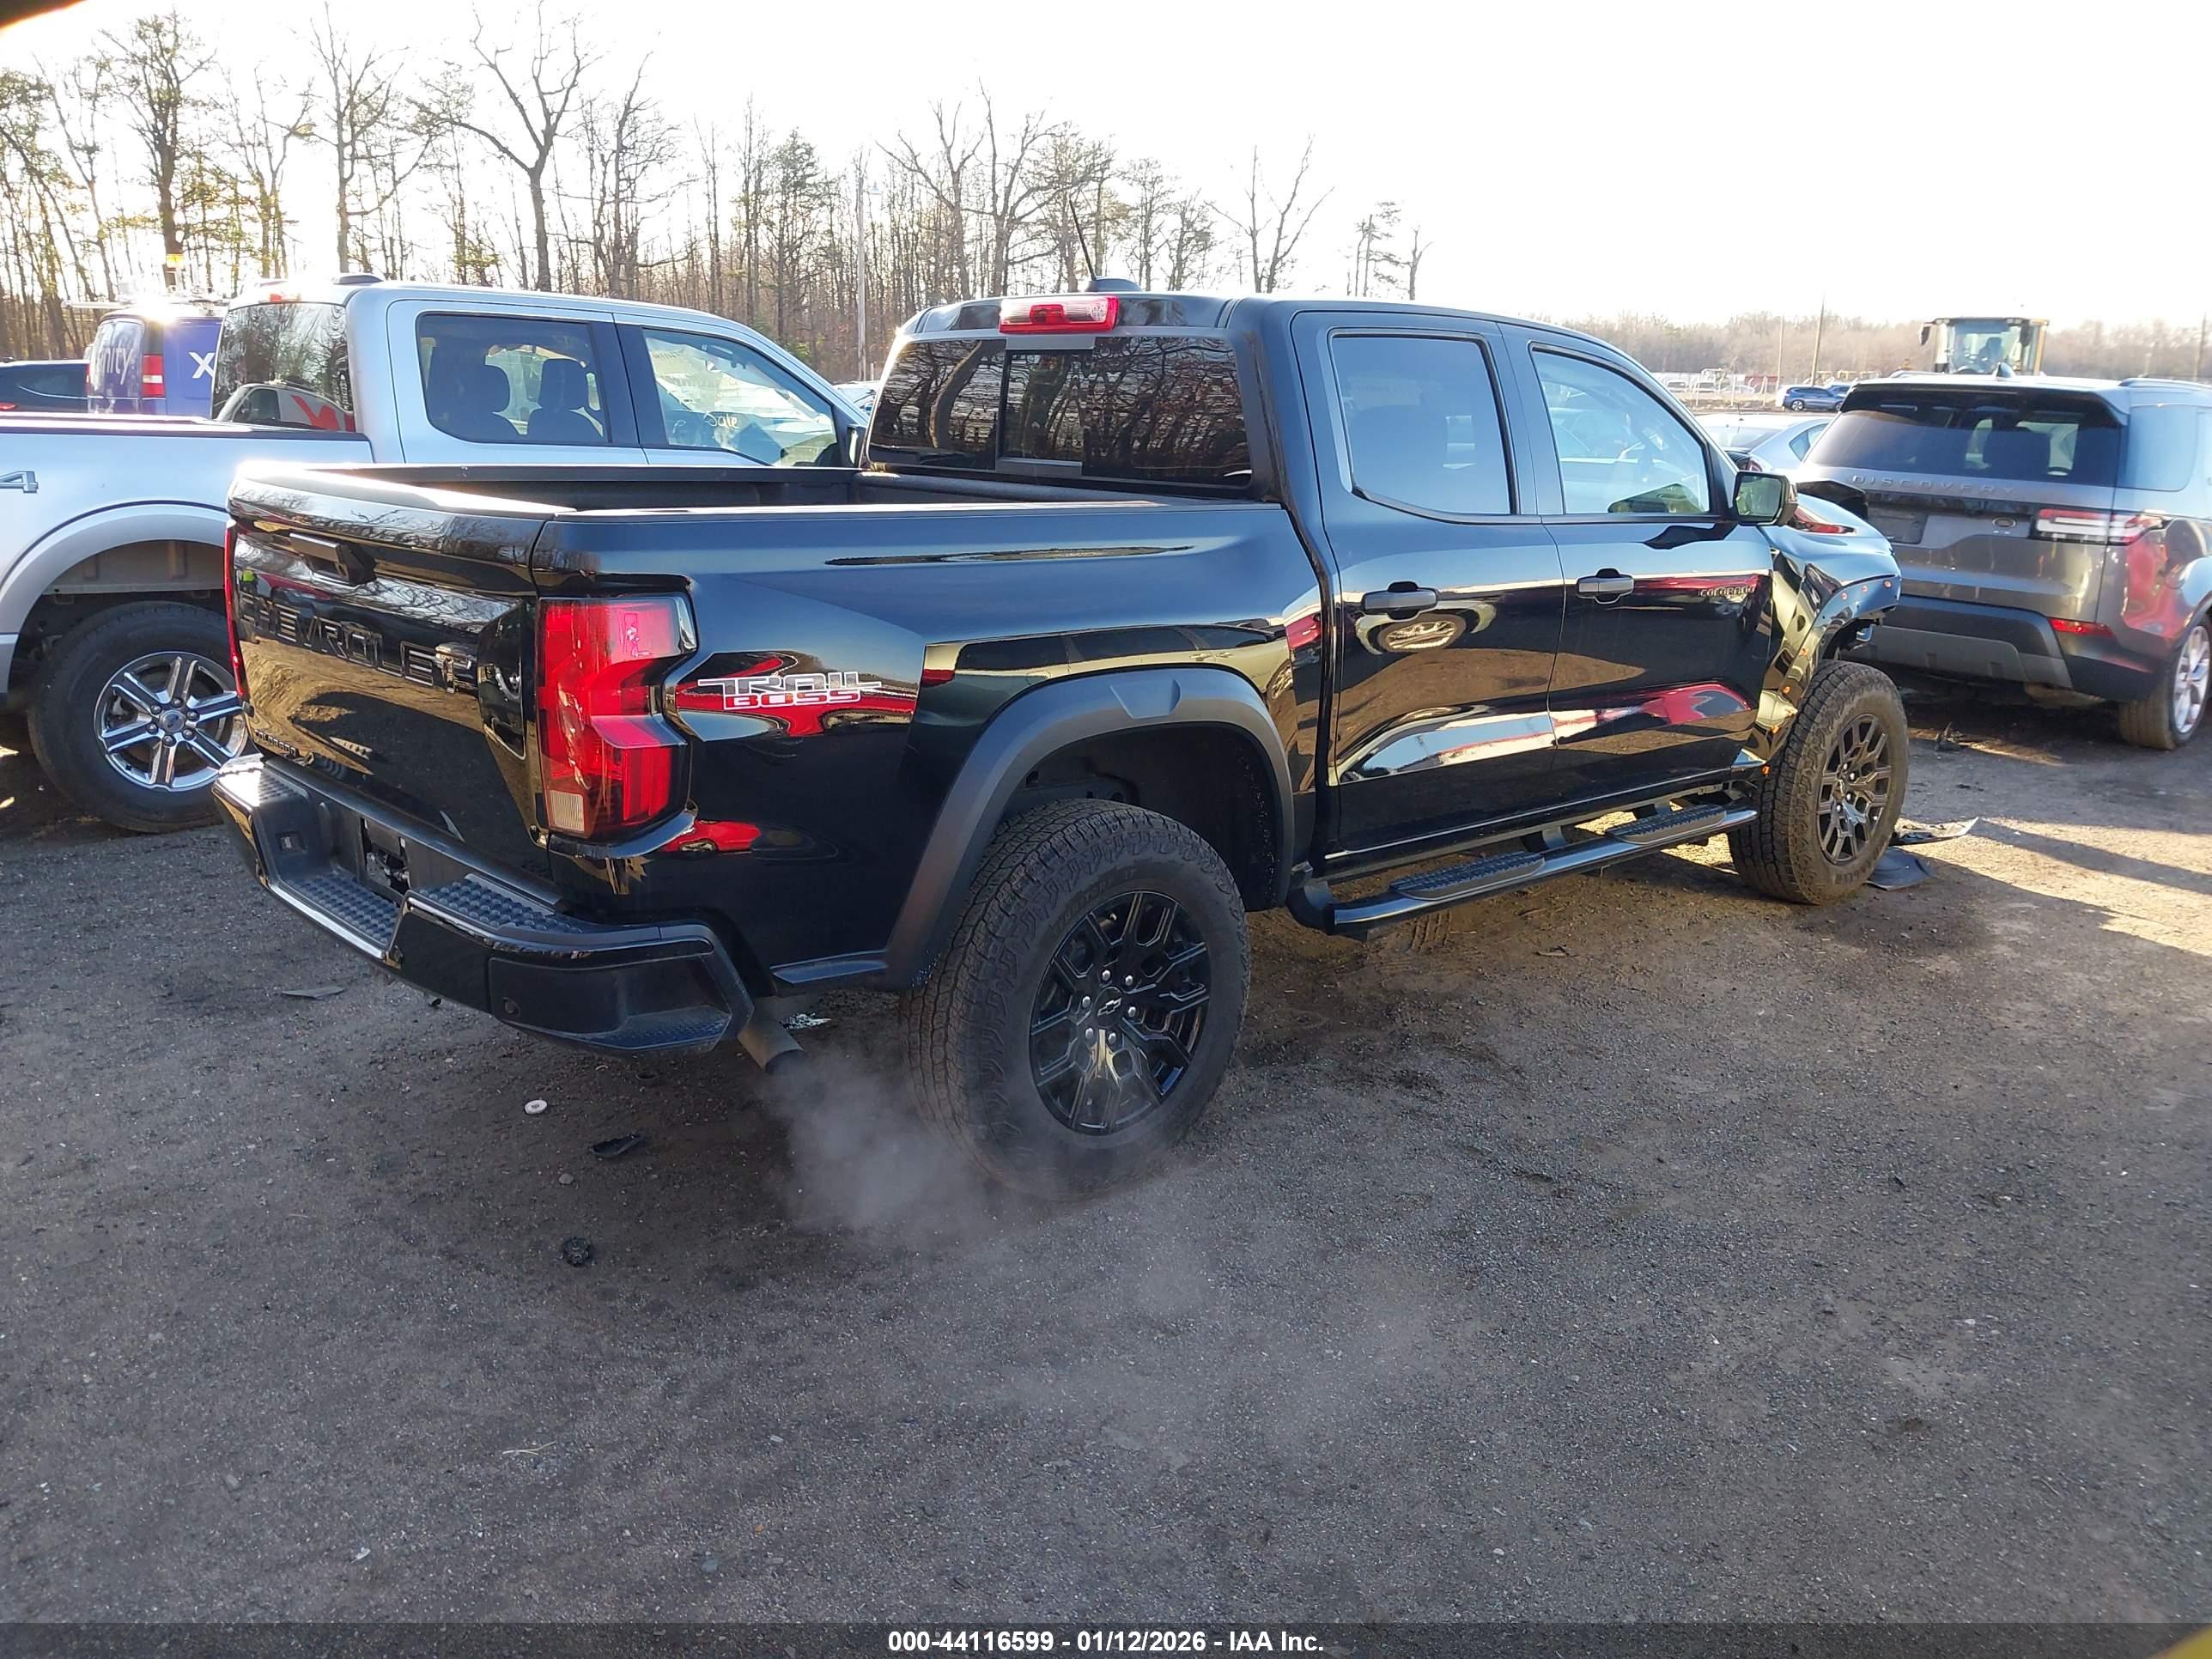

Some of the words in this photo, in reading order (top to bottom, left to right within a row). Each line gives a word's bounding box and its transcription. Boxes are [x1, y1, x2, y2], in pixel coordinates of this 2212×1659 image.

[1851, 474, 2016, 494] DISCOVERY
[1698, 585, 1756, 598] COLORADO
[239, 590, 477, 694] CHEVROLET
[697, 671, 882, 695] TRAIL
[723, 689, 862, 711] BOSS
